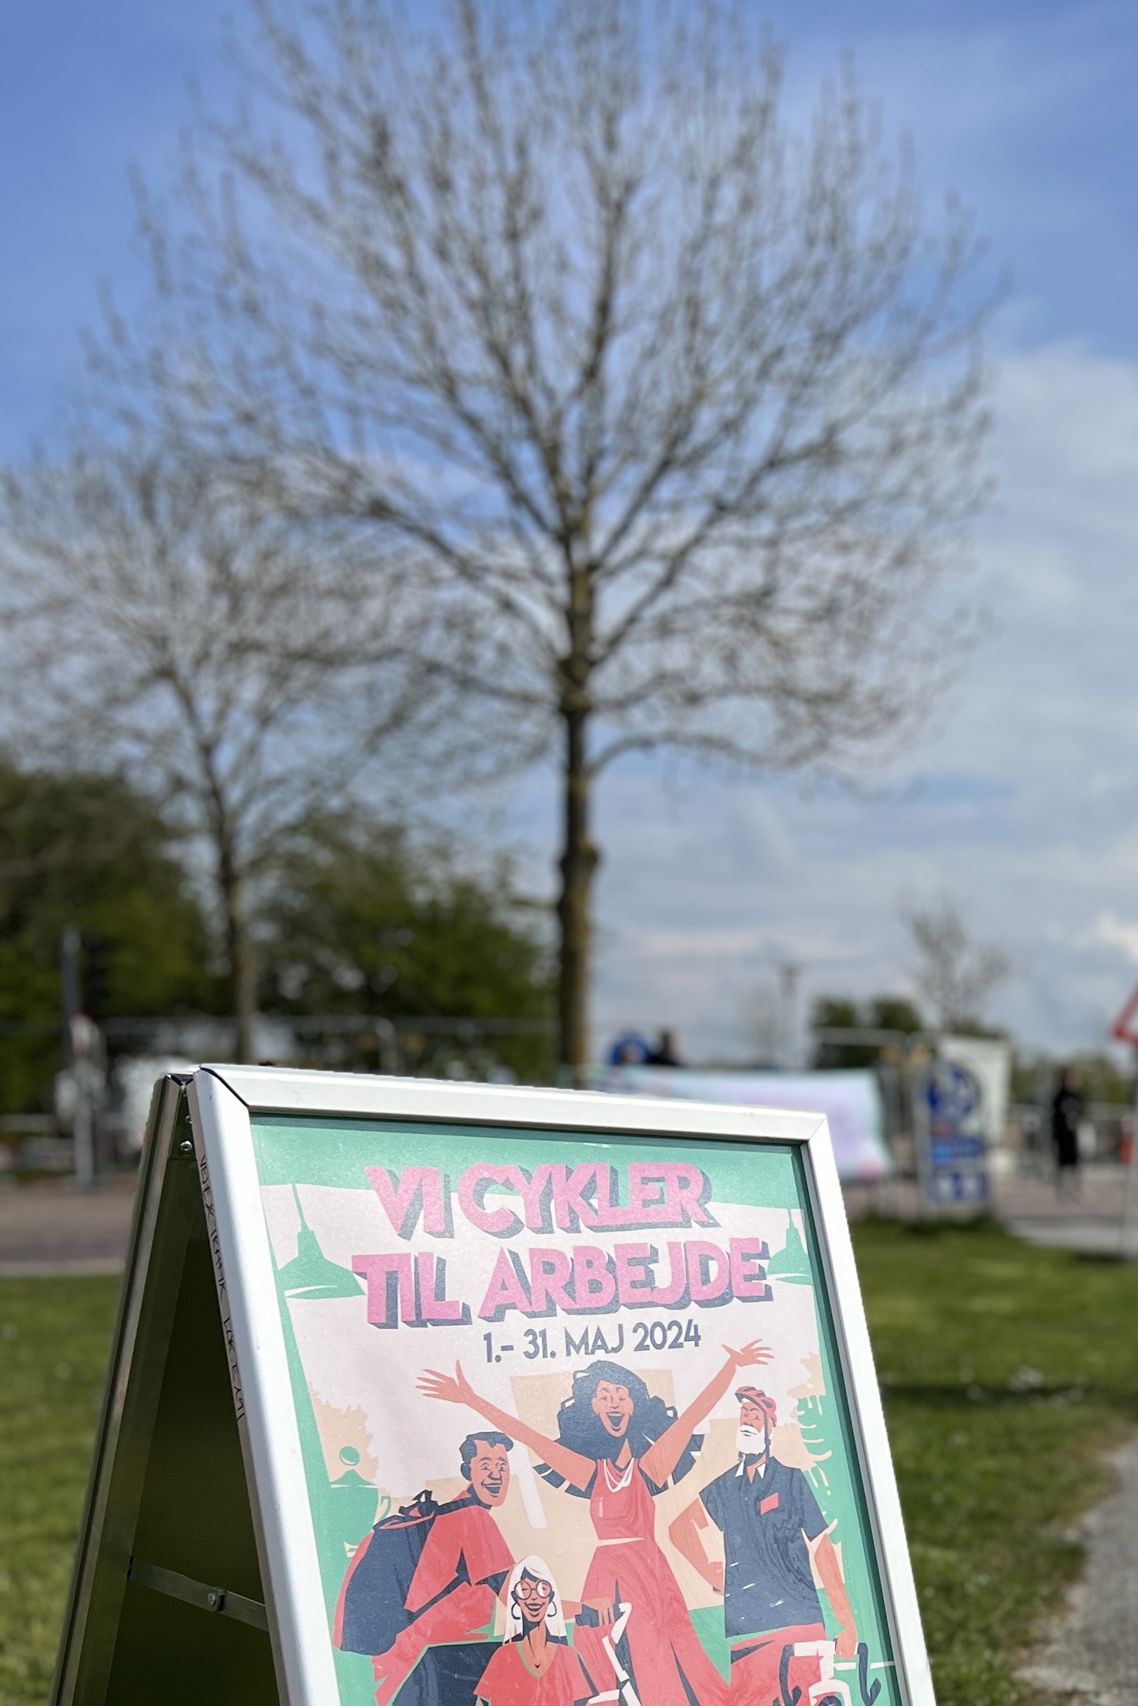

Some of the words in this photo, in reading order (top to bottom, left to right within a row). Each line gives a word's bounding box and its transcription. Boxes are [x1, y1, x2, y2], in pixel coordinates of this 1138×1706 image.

[364, 1164, 454, 1240] VI
[458, 1163, 721, 1237] CYKLER
[352, 1252, 472, 1329] TIL
[478, 1237, 774, 1320] ARBEJDE
[565, 1325, 625, 1356] MAJ
[632, 1318, 702, 1351] 2024
